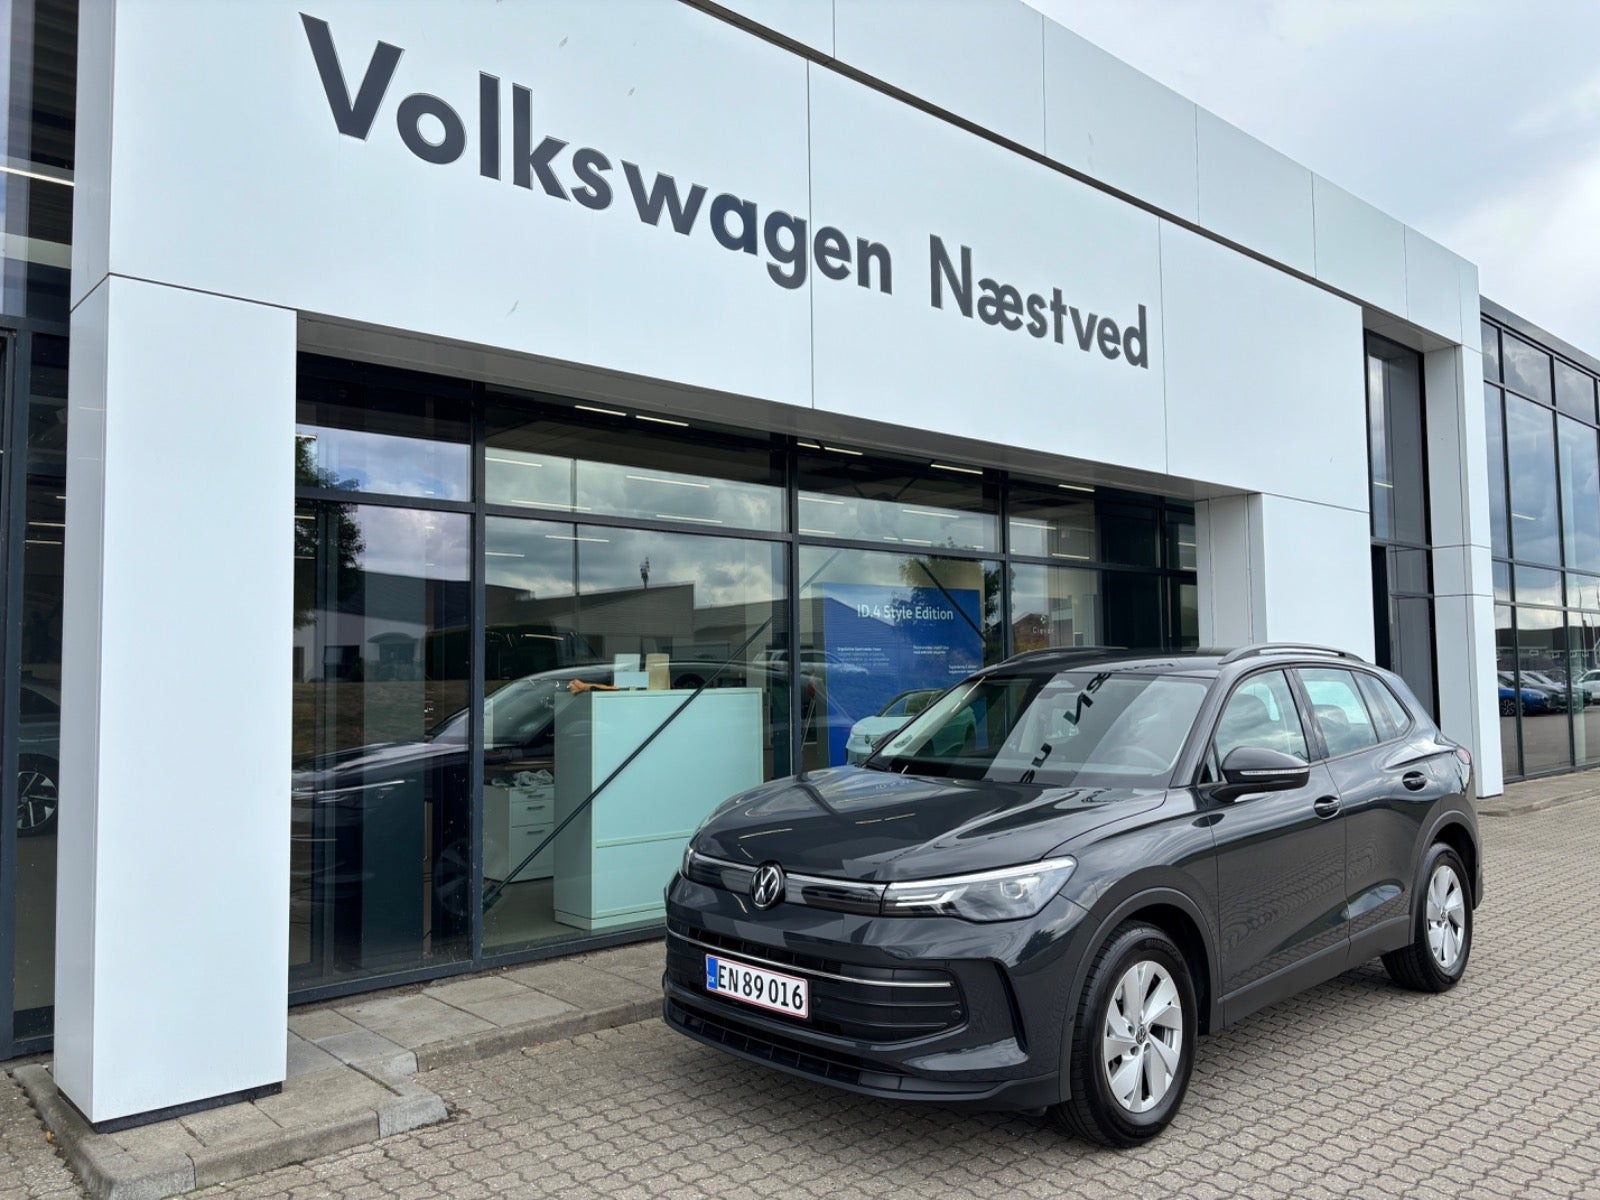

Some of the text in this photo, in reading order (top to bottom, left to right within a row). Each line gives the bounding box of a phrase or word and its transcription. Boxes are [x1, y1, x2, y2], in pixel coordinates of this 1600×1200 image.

[299, 12, 1149, 370] Volkswagen Næstved
[857, 603, 954, 622] ID.4 Style Edition
[718, 964, 804, 1010] EN 89 016
